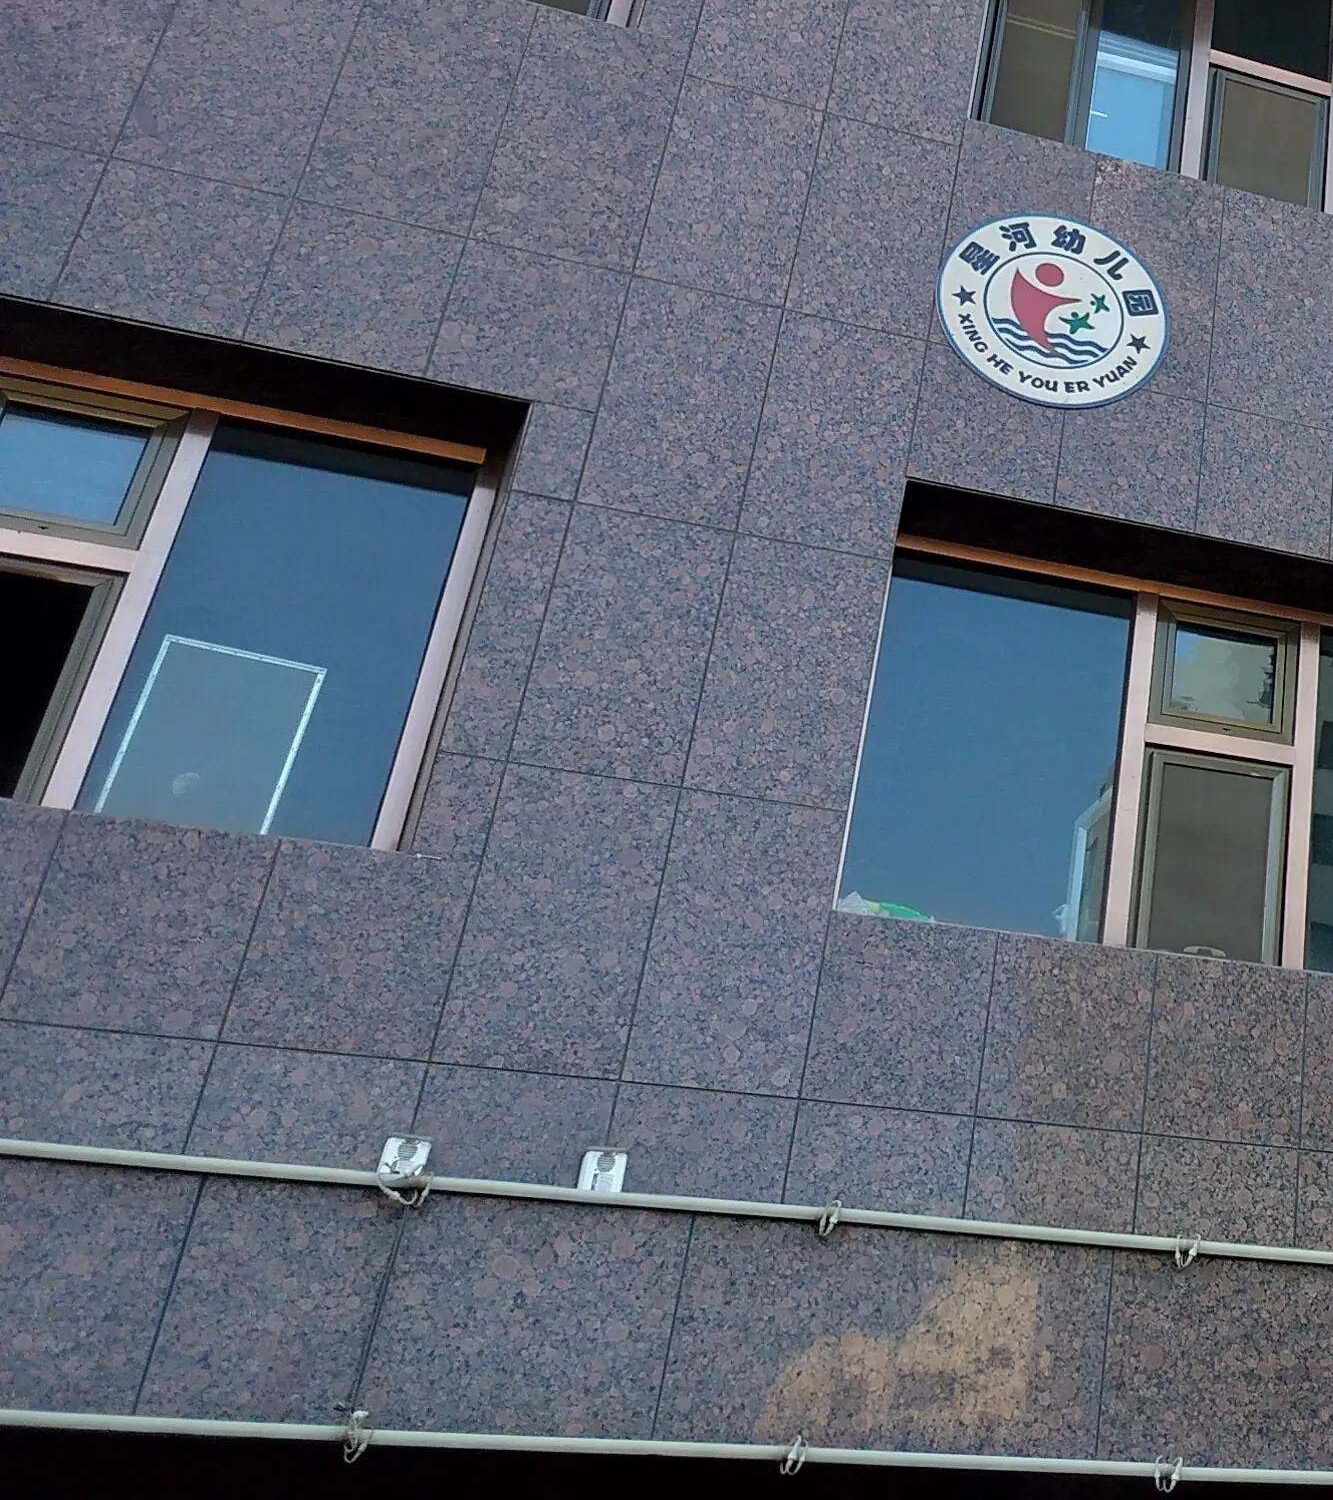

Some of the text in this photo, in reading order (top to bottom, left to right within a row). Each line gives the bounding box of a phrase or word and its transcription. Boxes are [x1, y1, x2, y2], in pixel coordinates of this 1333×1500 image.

[958, 221, 1159, 317] 星河幼儿园
[957, 312, 1138, 394] XING HE YOU ER YUAN
